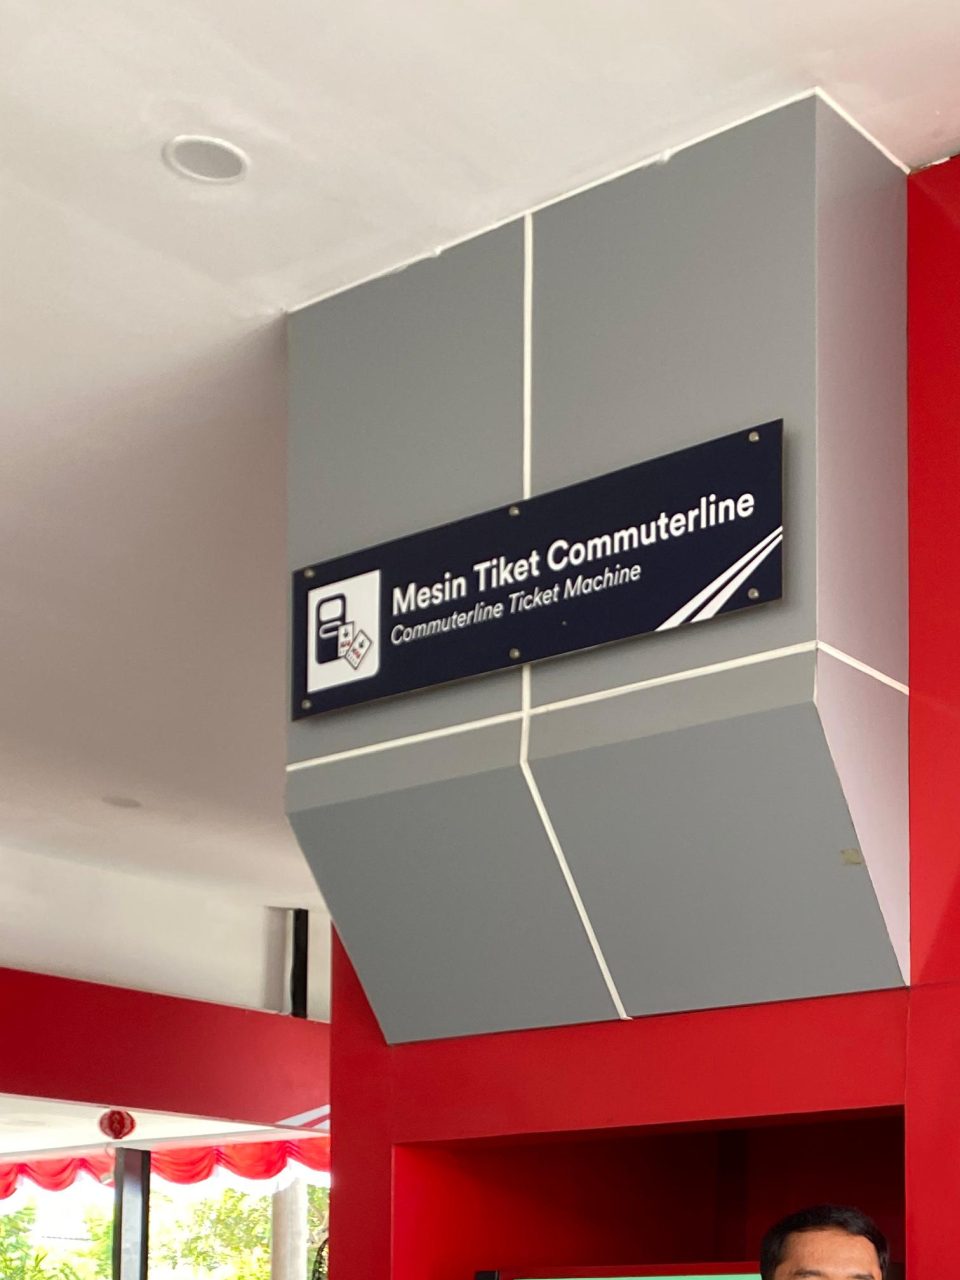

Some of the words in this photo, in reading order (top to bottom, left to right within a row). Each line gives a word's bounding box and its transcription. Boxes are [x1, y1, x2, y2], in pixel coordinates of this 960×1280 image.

[390, 601, 504, 645] Commuterline
[508, 583, 560, 614] Ticket
[563, 563, 642, 600] Machine
[392, 572, 467, 616] Mesin
[473, 549, 541, 592] Tiket
[546, 492, 755, 572] Commuterline
